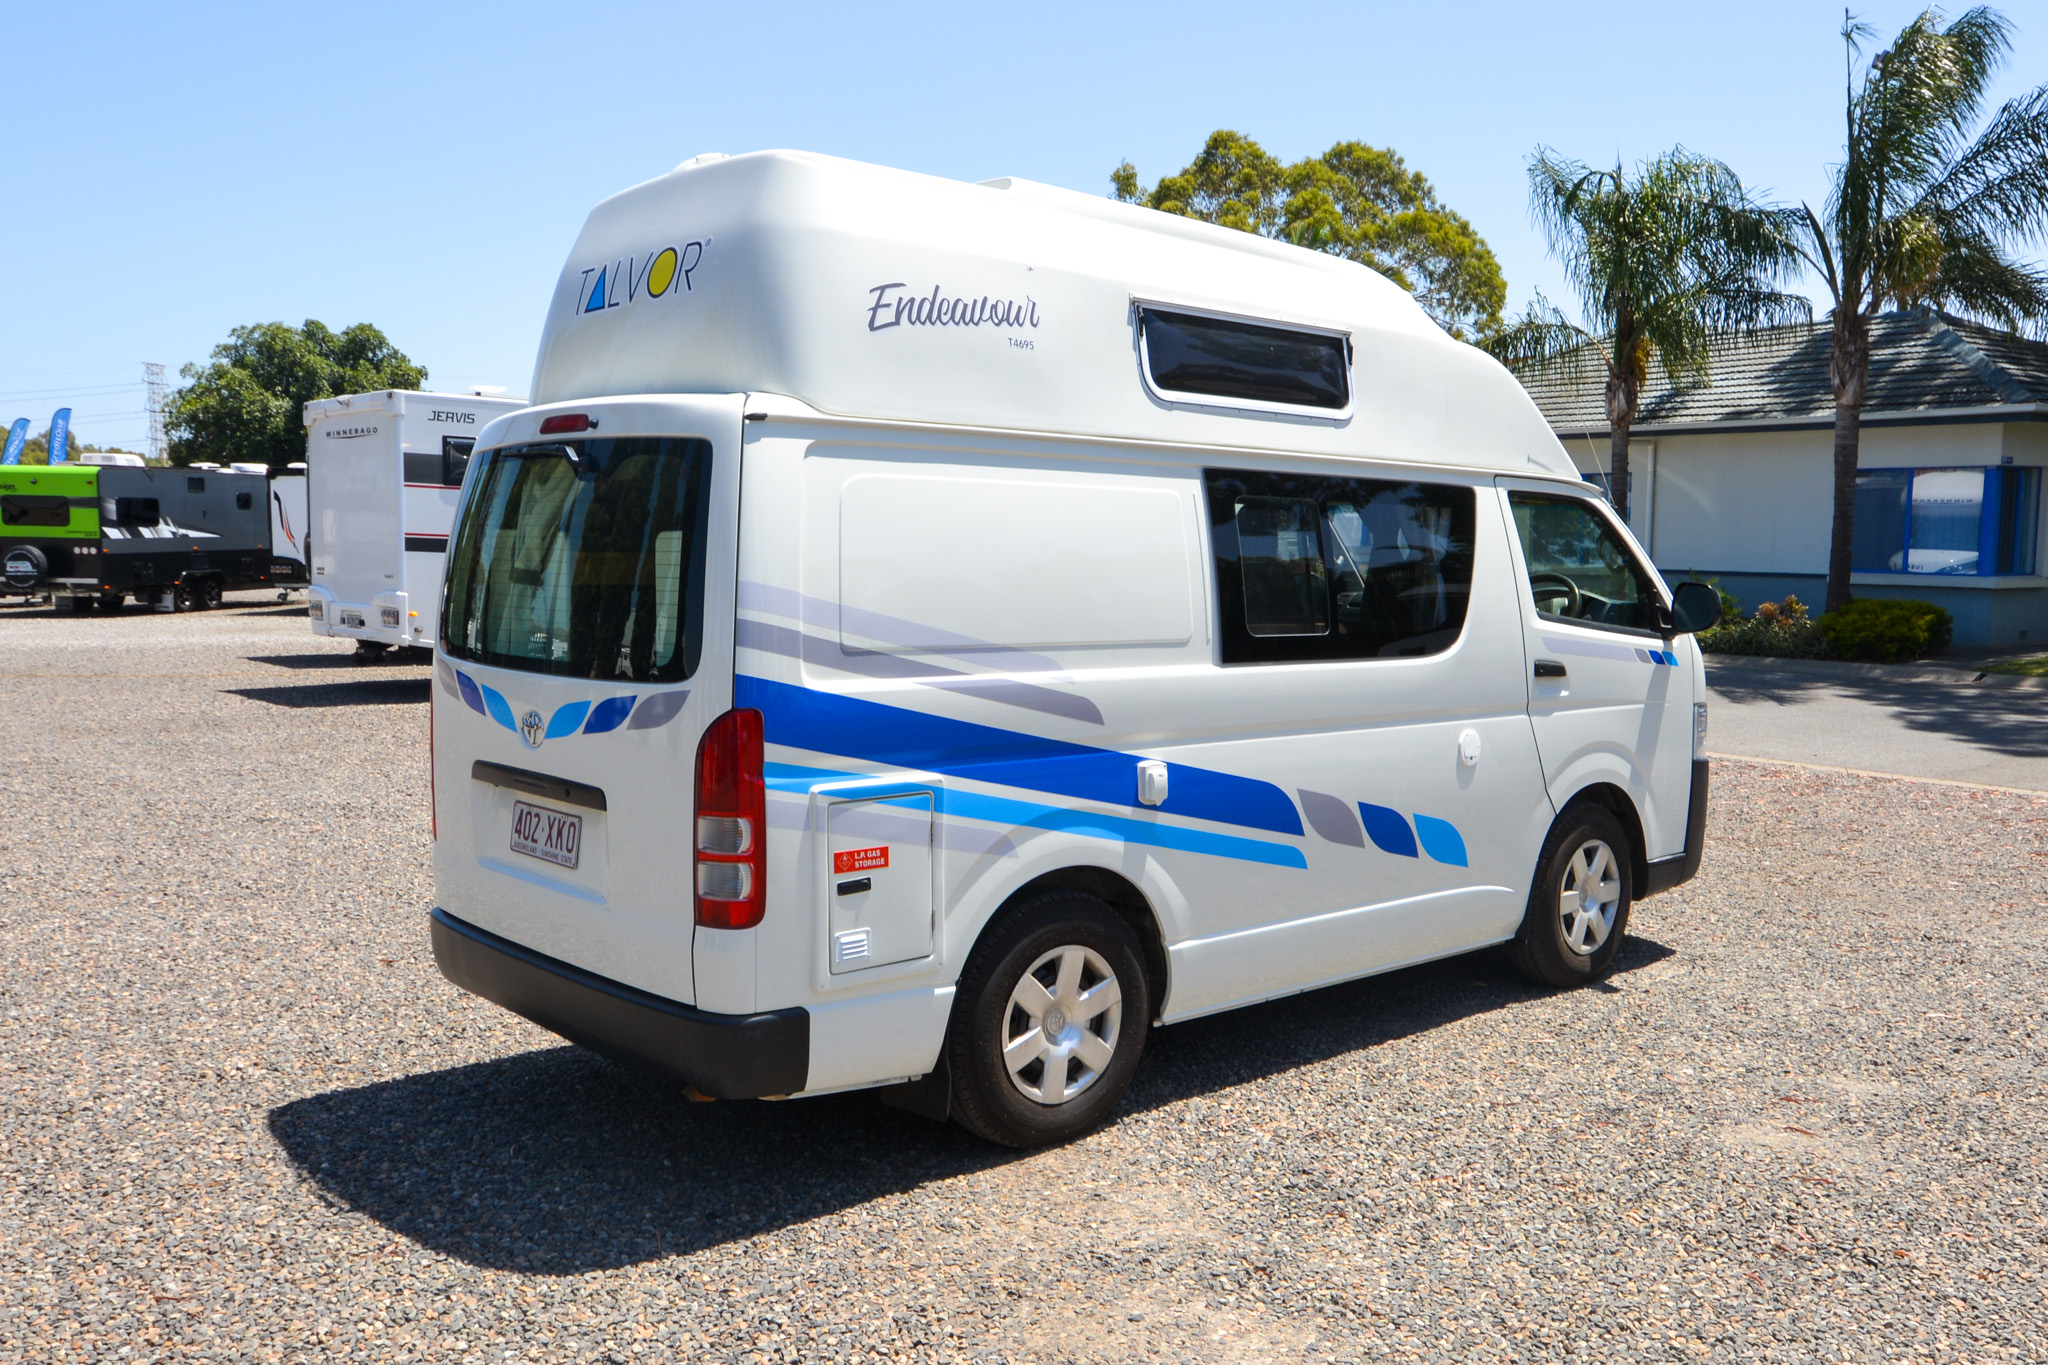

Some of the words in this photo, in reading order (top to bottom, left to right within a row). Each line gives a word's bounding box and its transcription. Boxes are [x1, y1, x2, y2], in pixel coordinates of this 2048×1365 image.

[576, 241, 703, 316] TALVOR
[867, 282, 1040, 332] Endeavour
[1007, 337, 1035, 350] T4695
[427, 410, 475, 424] JERVIS
[325, 426, 378, 437] WINNEBAGO
[513, 841, 537, 854] QUEENSLAND
[540, 849, 559, 862] SUNSHINE
[560, 855, 573, 866] STATE
[867, 849, 880, 857] GAS
[854, 857, 885, 868] STORAGE
